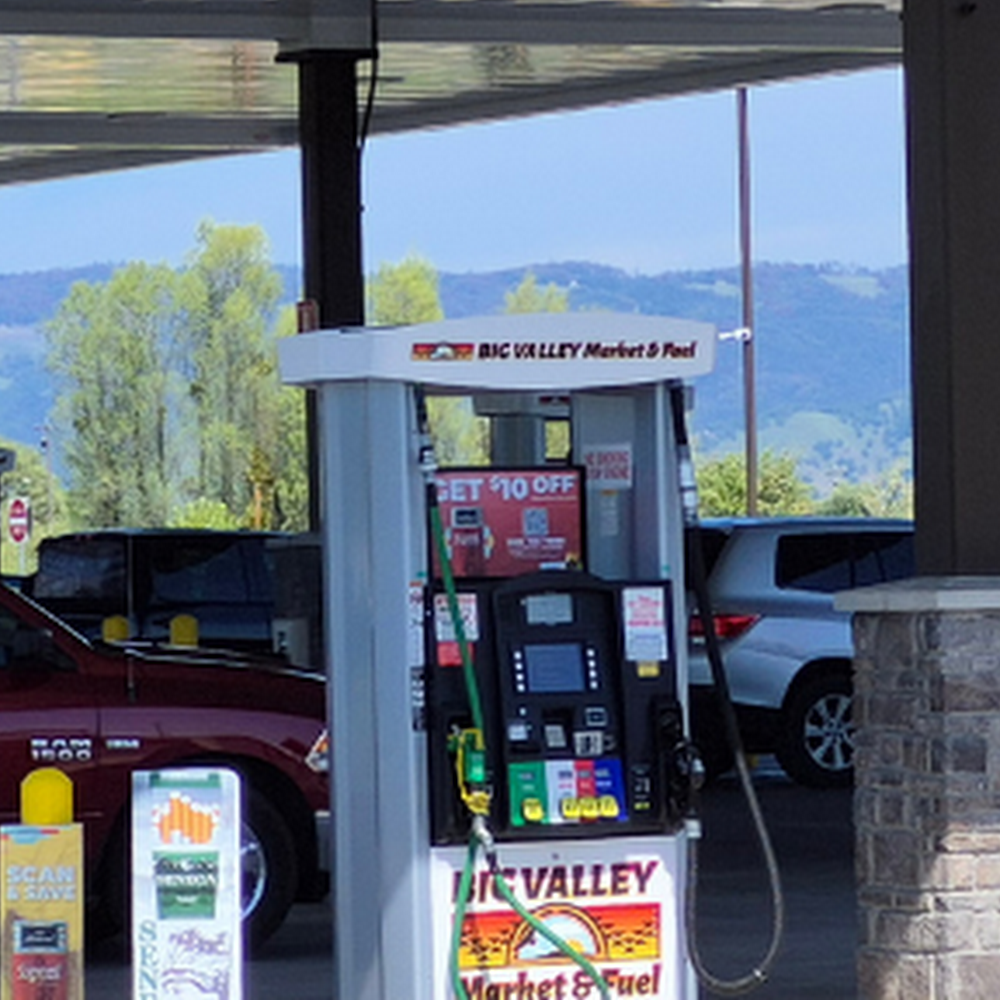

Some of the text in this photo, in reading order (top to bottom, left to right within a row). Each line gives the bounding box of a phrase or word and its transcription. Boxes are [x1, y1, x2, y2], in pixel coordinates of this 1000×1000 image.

[490, 476, 529, 501] $10
[533, 475, 576, 494] OFF
[7, 865, 76, 884] SCAN
[521, 861, 660, 901] VALLEY
[25, 886, 77, 902] SAVE
